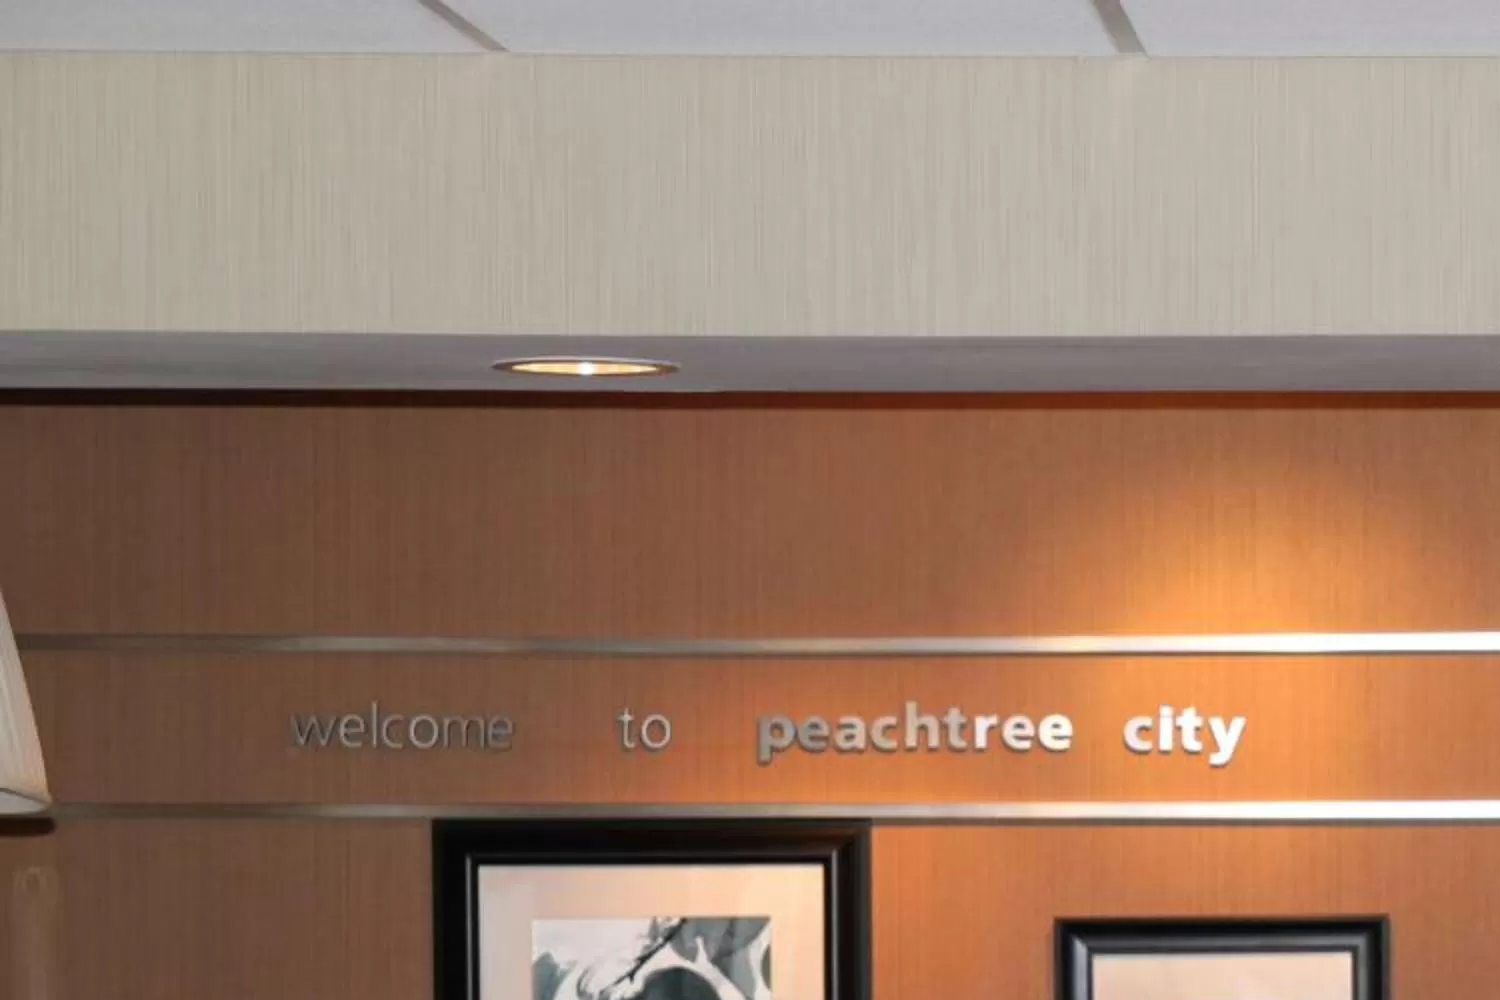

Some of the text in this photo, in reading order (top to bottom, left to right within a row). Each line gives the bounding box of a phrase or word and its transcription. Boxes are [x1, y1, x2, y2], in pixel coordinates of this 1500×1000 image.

[290, 700, 1246, 766] welcome to peachtree city
